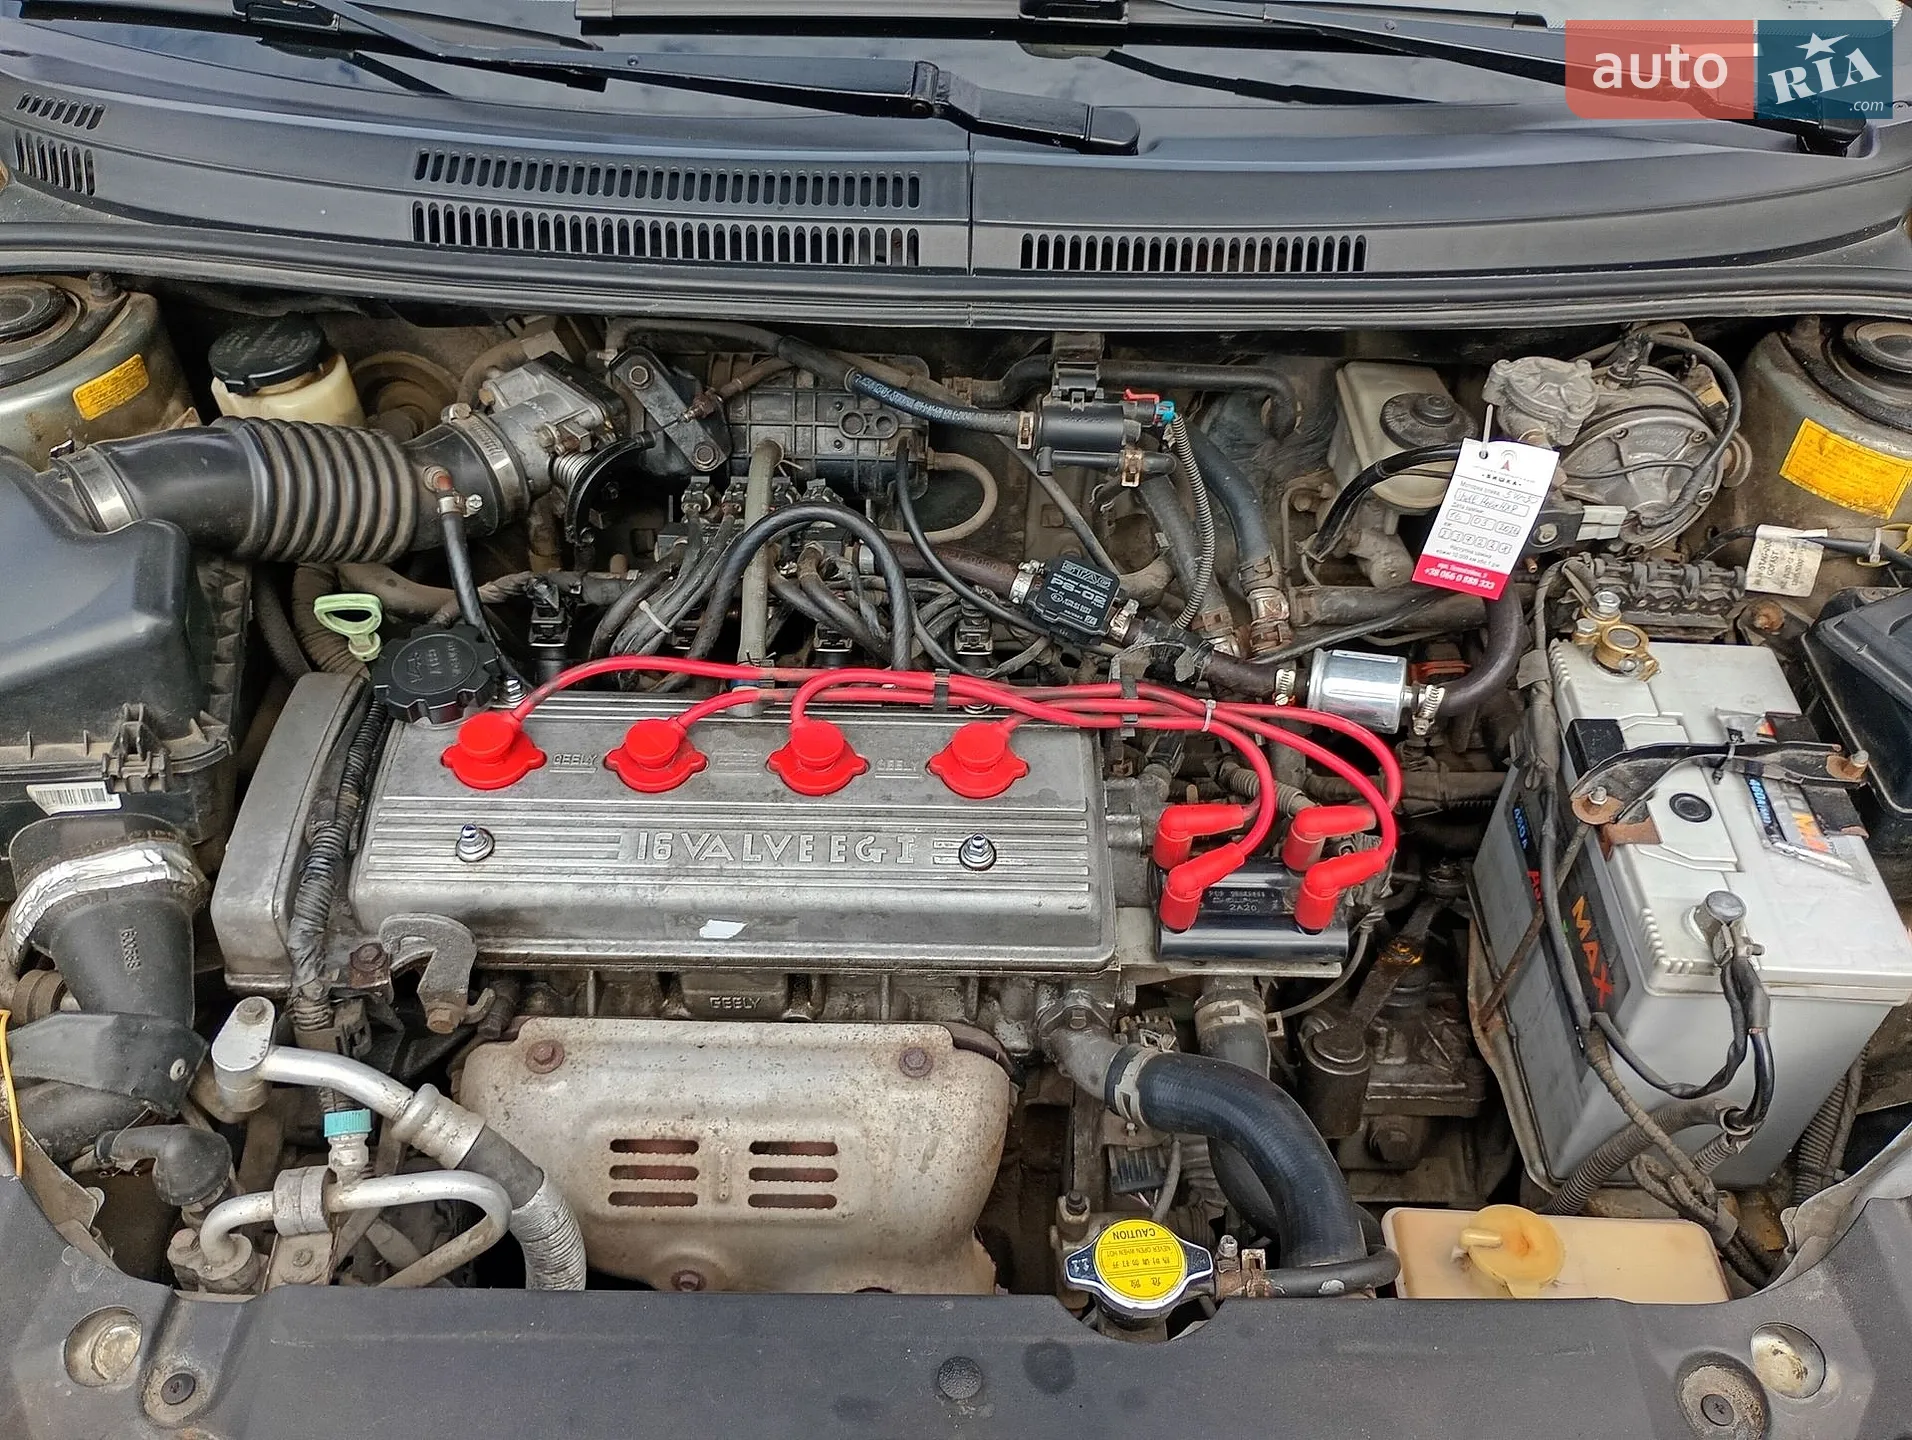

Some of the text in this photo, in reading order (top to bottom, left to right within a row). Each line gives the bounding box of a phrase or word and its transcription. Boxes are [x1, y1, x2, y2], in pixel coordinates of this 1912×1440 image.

[1051, 577, 1106, 604] PS-02
[553, 753, 598, 766] GEELY
[876, 759, 919, 771] GEELY
[636, 832, 674, 861] 16
[681, 832, 814, 863] VALVE
[1572, 895, 1614, 1009] MAX
[709, 996, 761, 1009] GEELY
[1112, 1228, 1156, 1240] CAUTION
